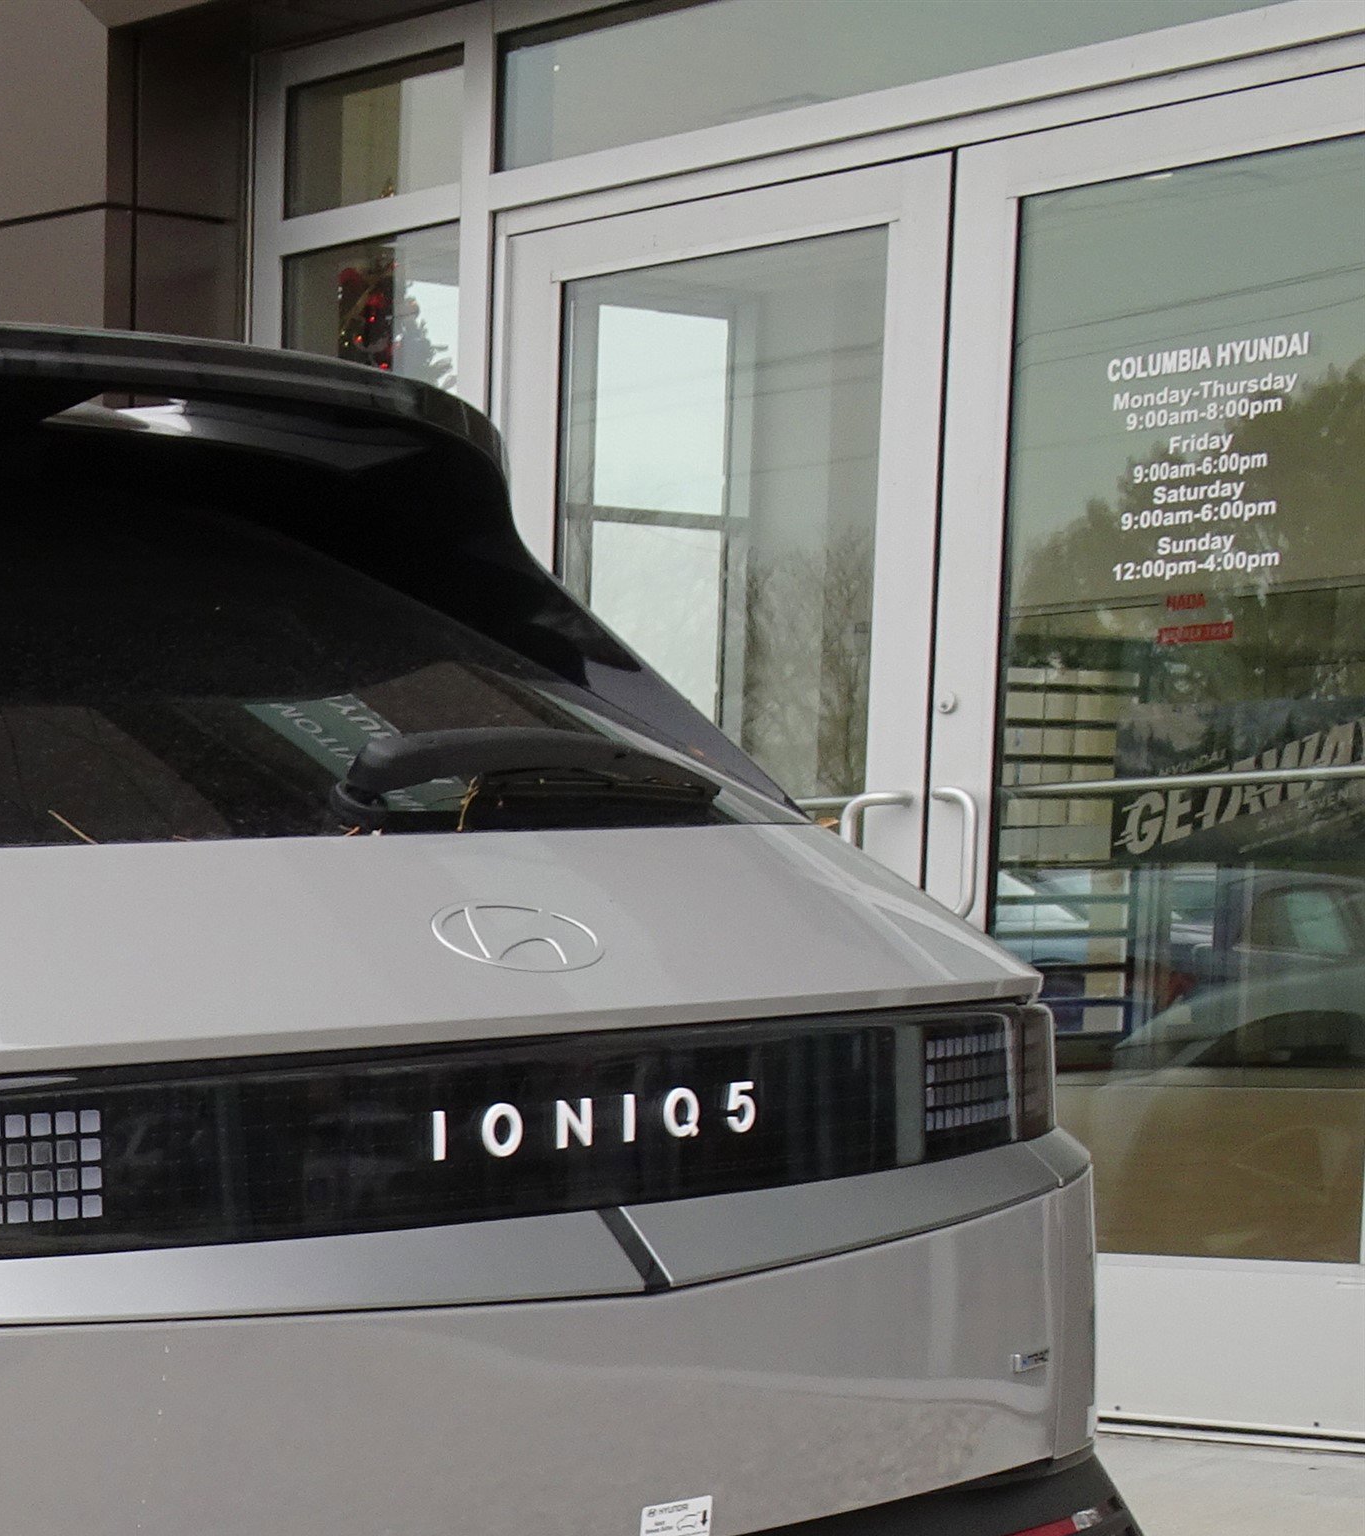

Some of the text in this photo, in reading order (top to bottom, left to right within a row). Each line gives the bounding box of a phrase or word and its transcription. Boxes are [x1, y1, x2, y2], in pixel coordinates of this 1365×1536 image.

[1107, 331, 1310, 383] COLUMBIA HYUNDAI
[1112, 371, 1299, 412] Monday-Thursday
[1126, 397, 1283, 432] 9:00am-8:00pm
[1169, 431, 1235, 455] Friday
[1133, 451, 1269, 485] 9:00am-6:00pm
[1152, 480, 1246, 505] Saturday
[1120, 499, 1278, 531] 9:00am-6:00pm
[1157, 531, 1236, 556] Sunday
[1112, 551, 1281, 582] 12:00pm-4:00pm
